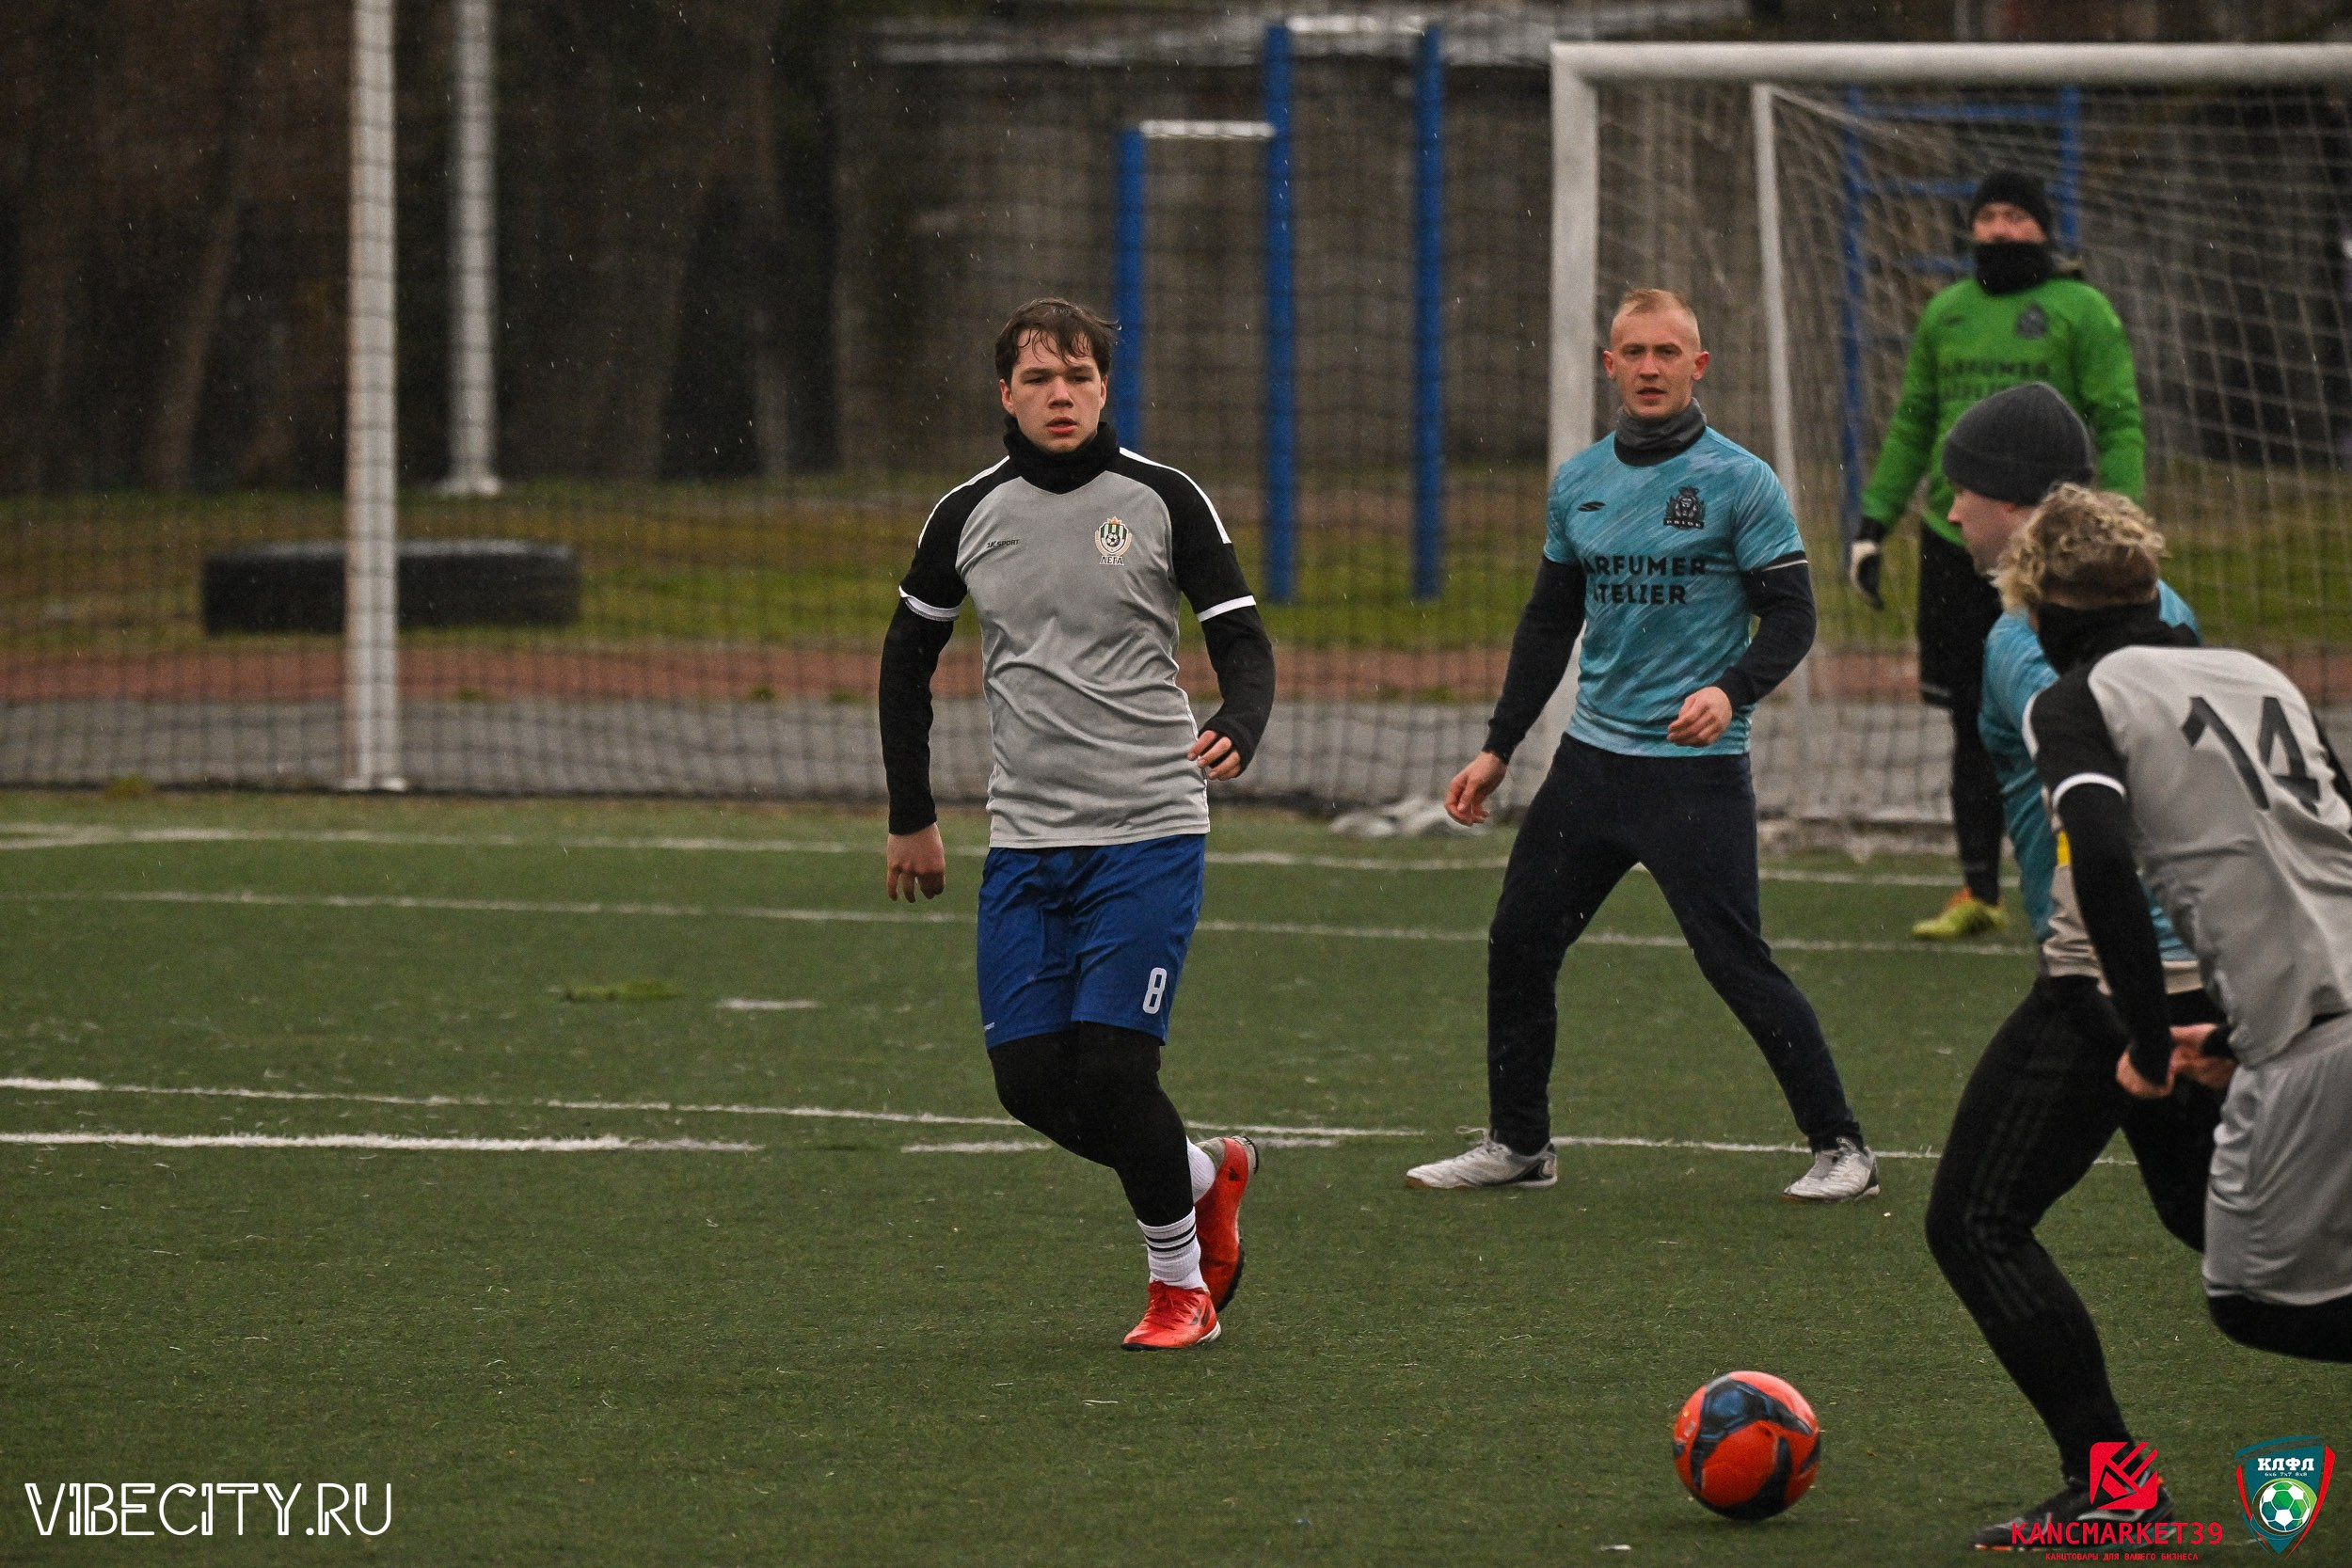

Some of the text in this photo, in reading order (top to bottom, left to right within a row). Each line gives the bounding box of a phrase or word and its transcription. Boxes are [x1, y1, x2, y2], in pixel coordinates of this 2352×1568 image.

[1100, 556, 1124, 565] ЛЕГА
[1582, 555, 1706, 577] ARFUMER
[2180, 696, 2321, 816] 14
[1142, 967, 1168, 1015] 8
